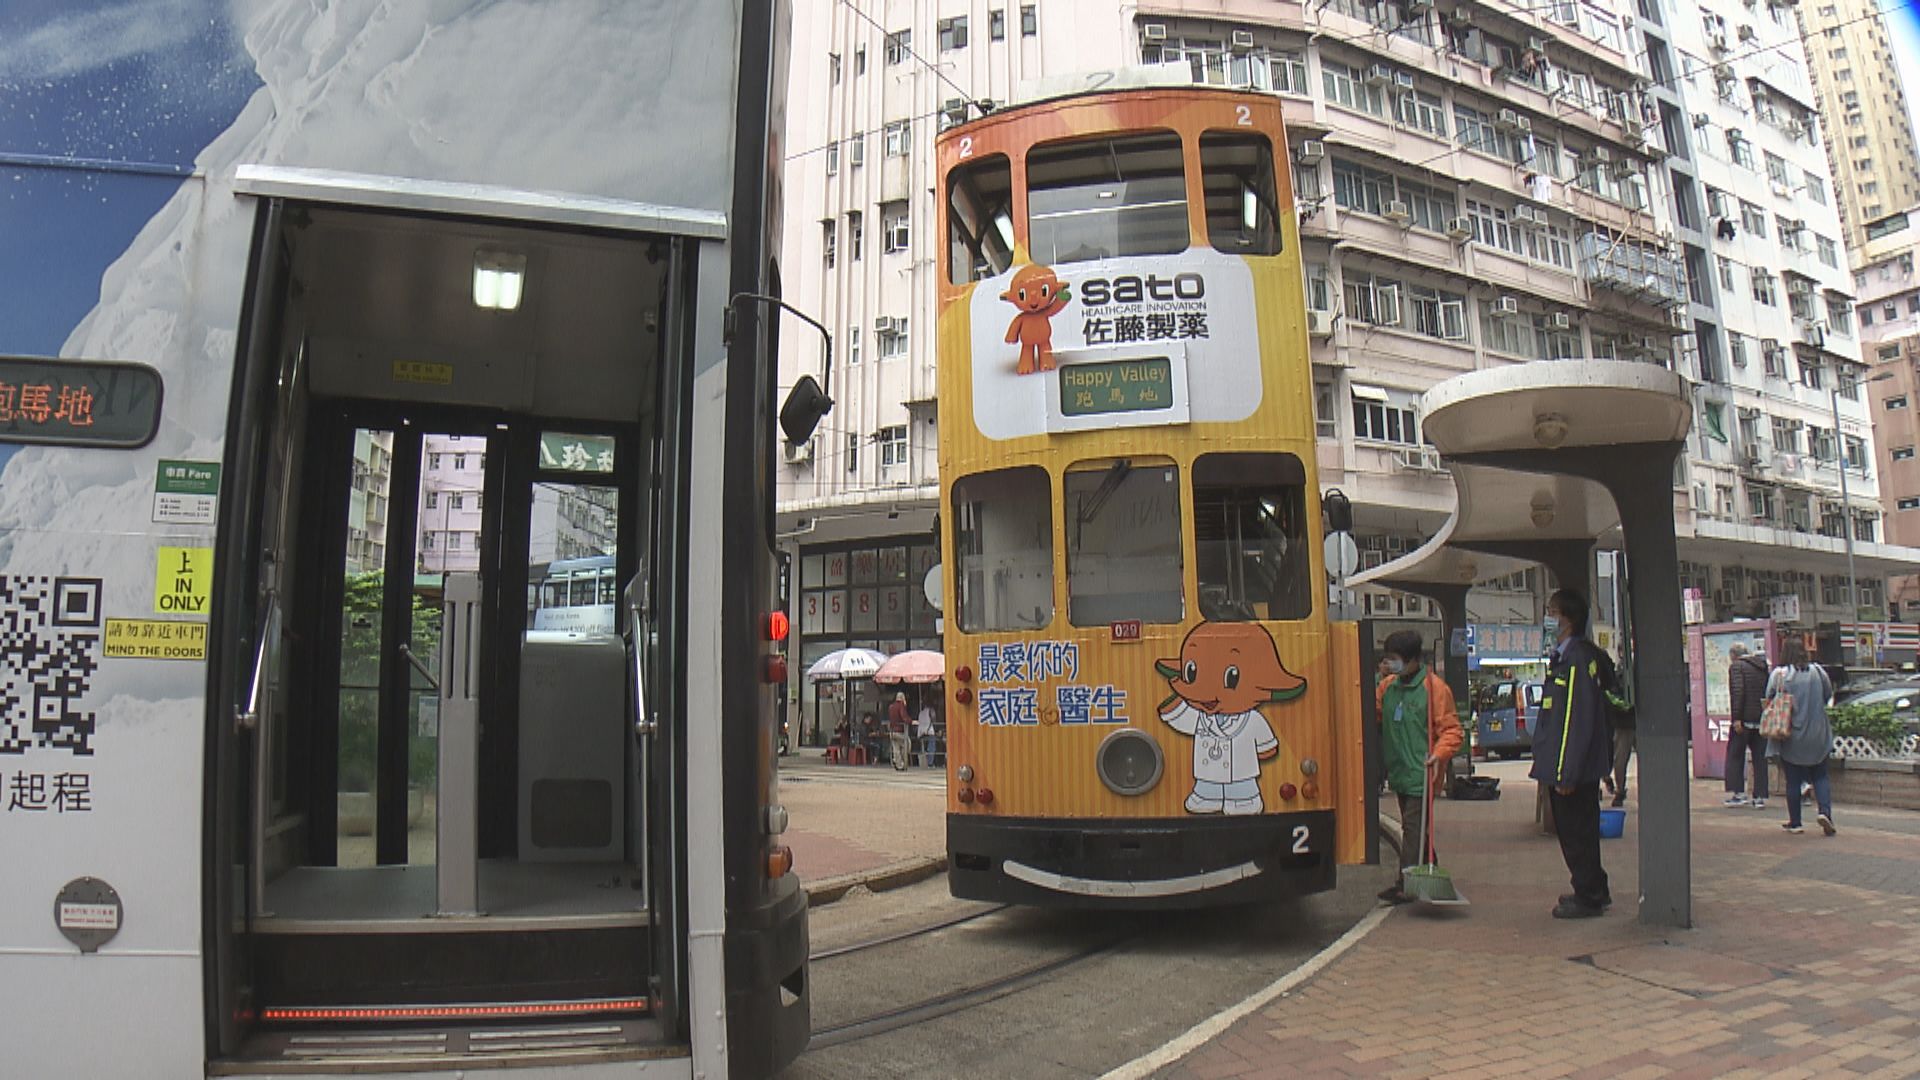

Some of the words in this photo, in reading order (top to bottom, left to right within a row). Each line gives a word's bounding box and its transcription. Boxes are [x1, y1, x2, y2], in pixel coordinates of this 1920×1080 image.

[1236, 105, 1253, 126] 2
[959, 137, 973, 159] 2
[1081, 272, 1205, 307] sato
[1082, 303, 1142, 317] HEALTHCARE
[1146, 302, 1207, 312] INNOVATION
[1064, 369, 1113, 387] Happy
[1120, 365, 1167, 383] Valley
[176, 550, 194, 574] 上
[175, 578, 192, 593] IN
[160, 594, 206, 611] ONLY
[1114, 623, 1137, 638] 029
[106, 644, 136, 656] MIND
[139, 645, 160, 656] THE
[164, 647, 203, 657] DOORS
[979, 640, 1079, 682] 最愛你的
[0, 770, 91, 813] 起程
[1292, 825, 1310, 854] 2
